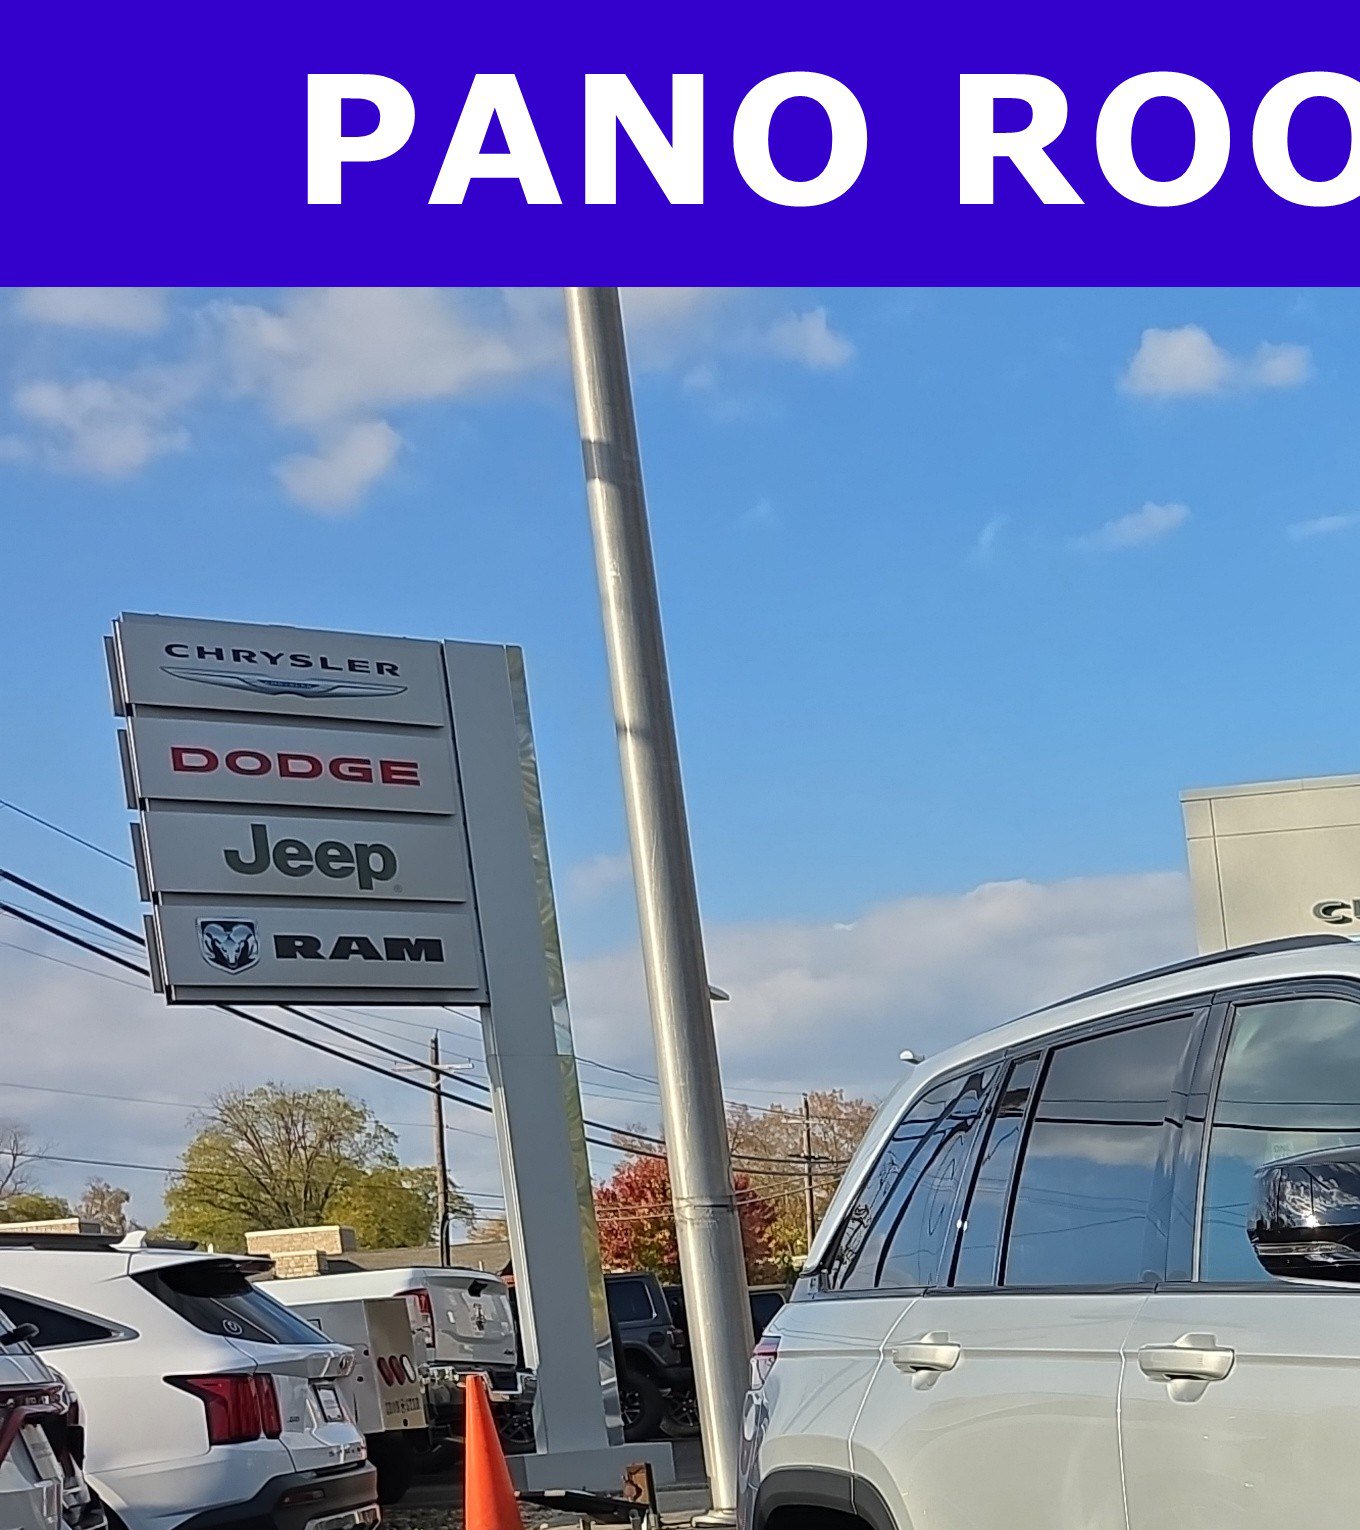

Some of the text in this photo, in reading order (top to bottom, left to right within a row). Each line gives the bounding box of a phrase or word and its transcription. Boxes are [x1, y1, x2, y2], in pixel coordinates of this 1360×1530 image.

[164, 643, 400, 676] CHRYSLER
[170, 746, 421, 786] DODGE
[223, 823, 398, 890] Jeep
[273, 934, 445, 962] RAM
